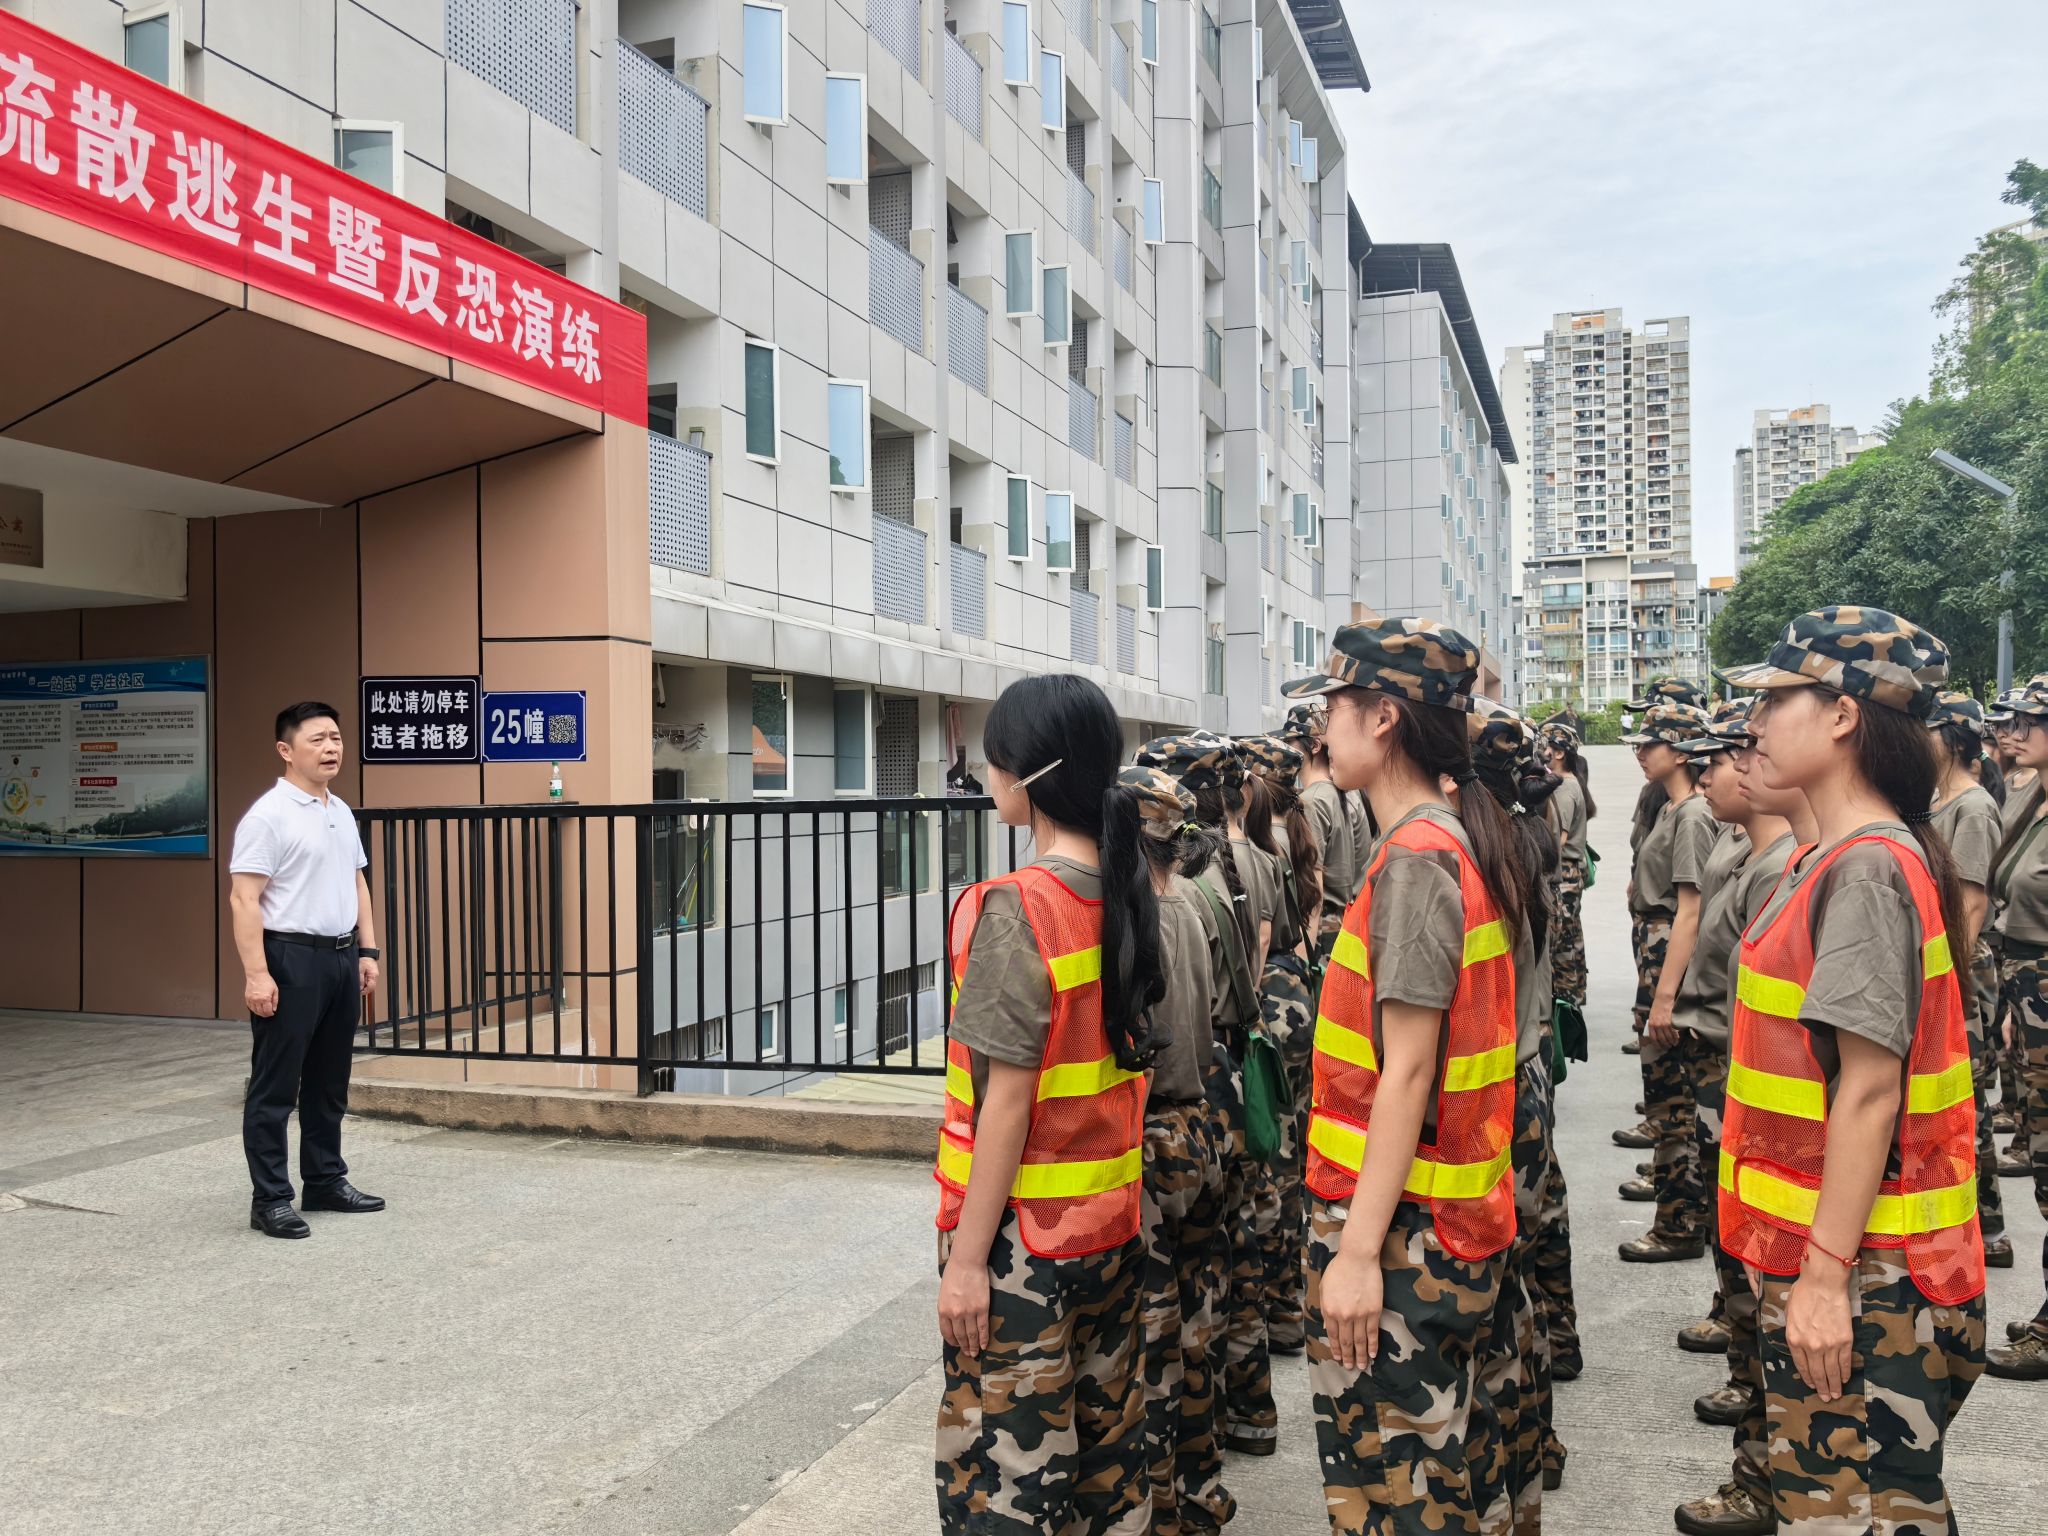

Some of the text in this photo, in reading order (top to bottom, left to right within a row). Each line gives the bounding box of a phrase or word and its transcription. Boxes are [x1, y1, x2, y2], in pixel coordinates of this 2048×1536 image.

[371, 690, 469, 714] 此处请勿停车
[371, 723, 469, 750] 违者拖移
[491, 708, 545, 744] 25幢
